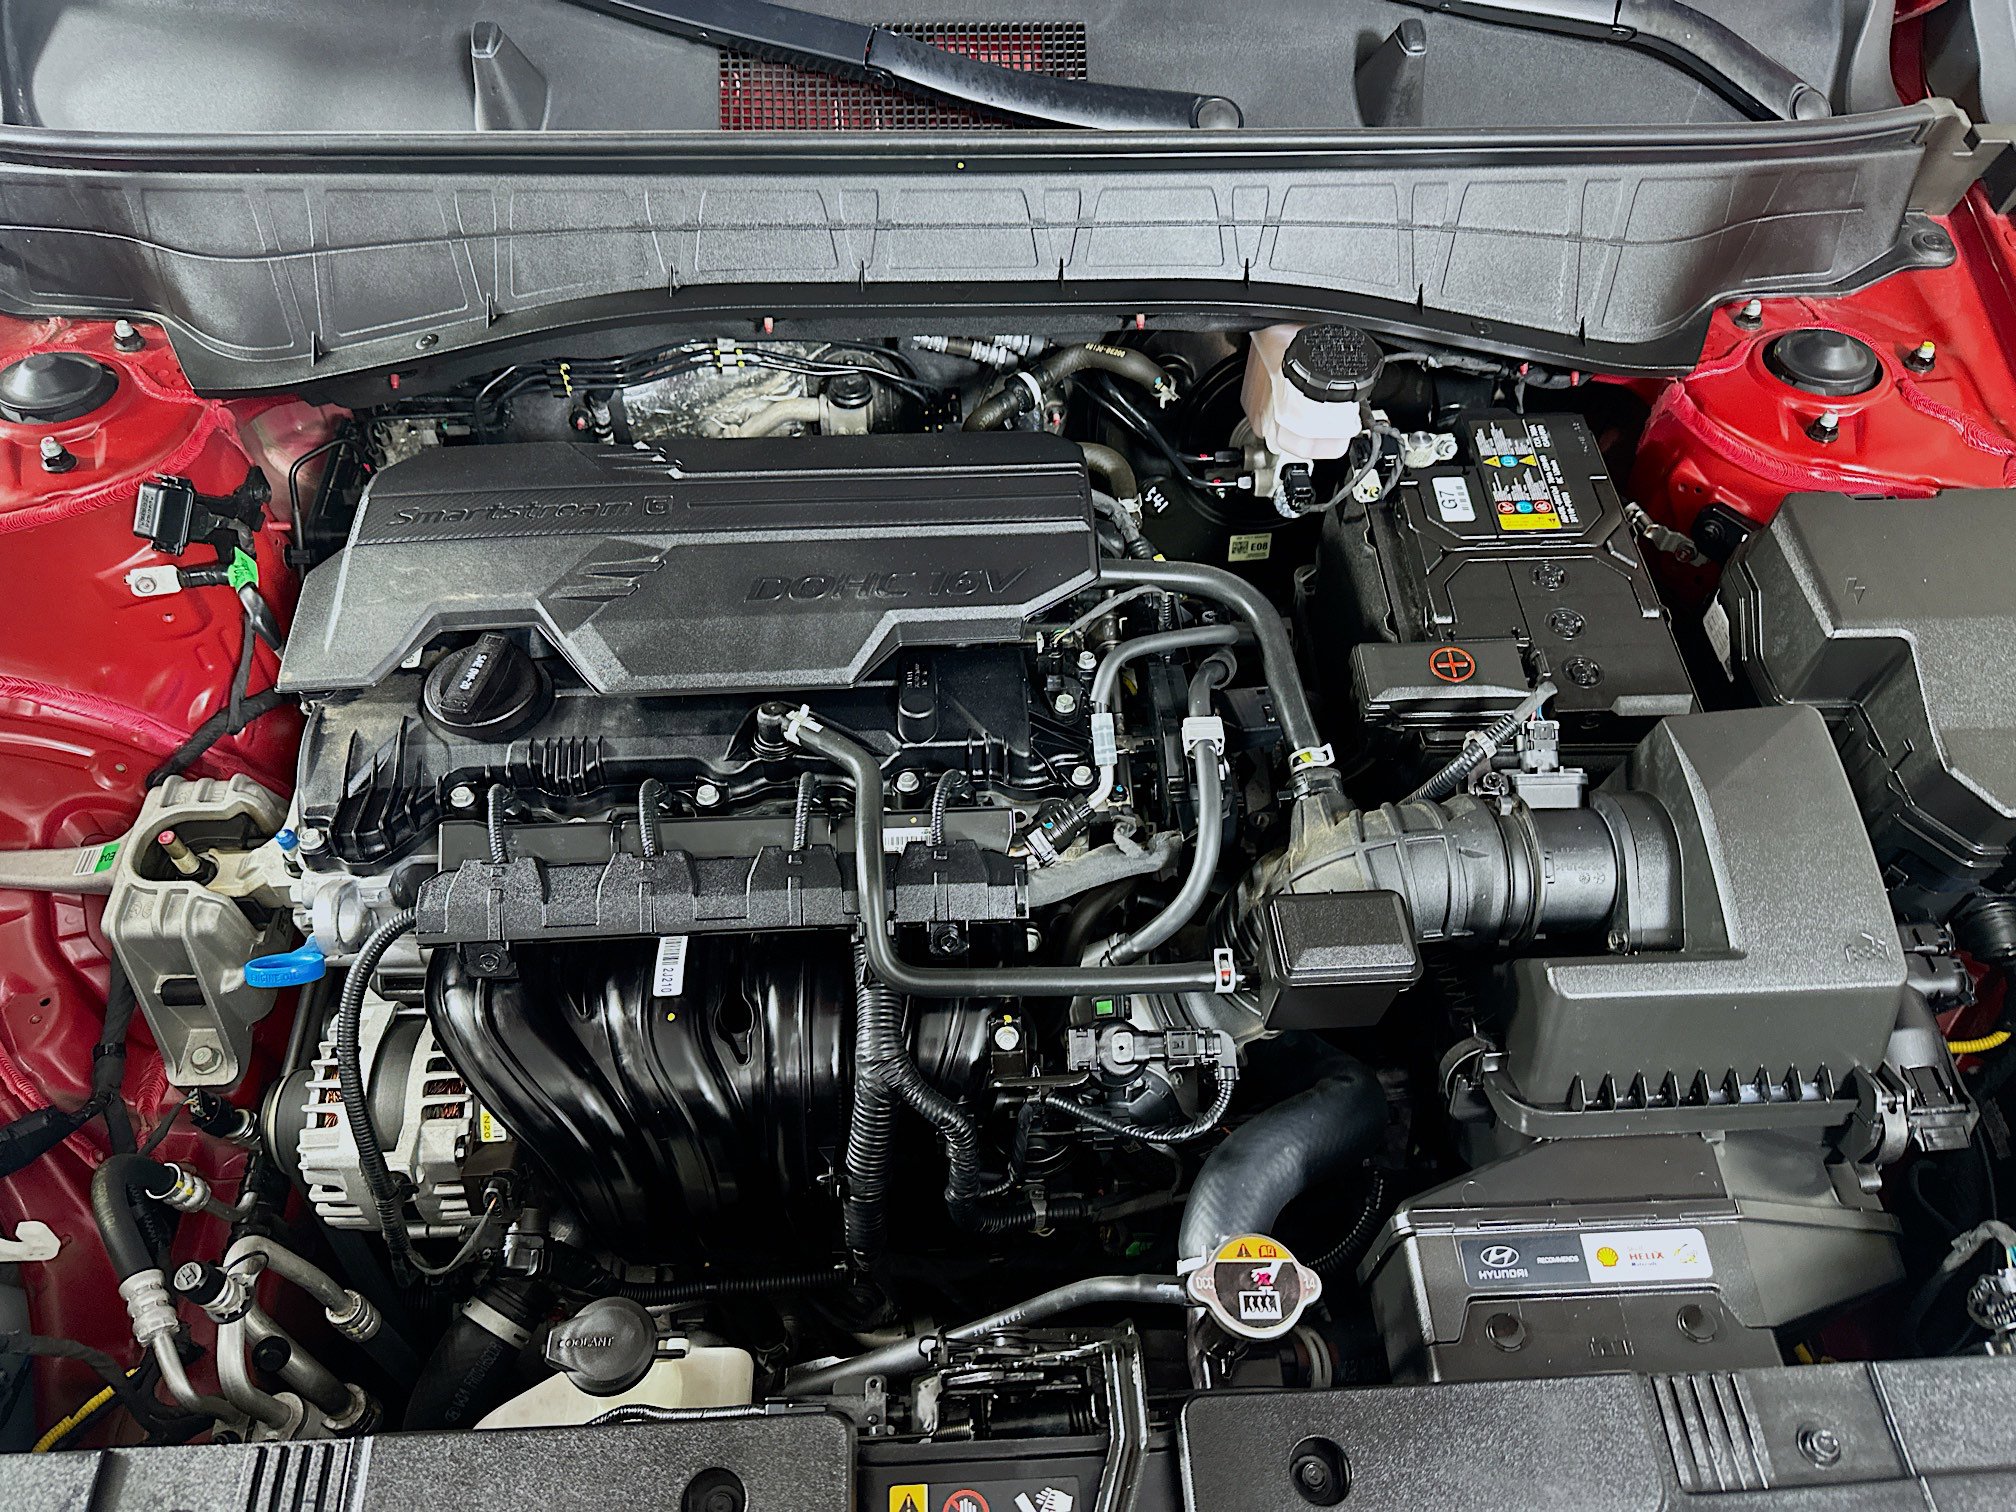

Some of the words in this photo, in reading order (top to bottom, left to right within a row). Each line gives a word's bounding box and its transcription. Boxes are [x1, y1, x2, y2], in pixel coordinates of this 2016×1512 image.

[1145, 486, 1169, 513] S41
[1439, 490, 1457, 509] G7
[386, 501, 633, 527] Smartstream
[743, 571, 917, 601] DOHC
[928, 565, 1033, 597] 16V
[660, 967, 674, 993] 2J210
[1478, 1268, 1529, 1280] HYUNDAI
[1536, 1254, 1580, 1265] RECOMMENDS
[1629, 1252, 1664, 1260] HELIX
[557, 1336, 615, 1348] COOLANT
